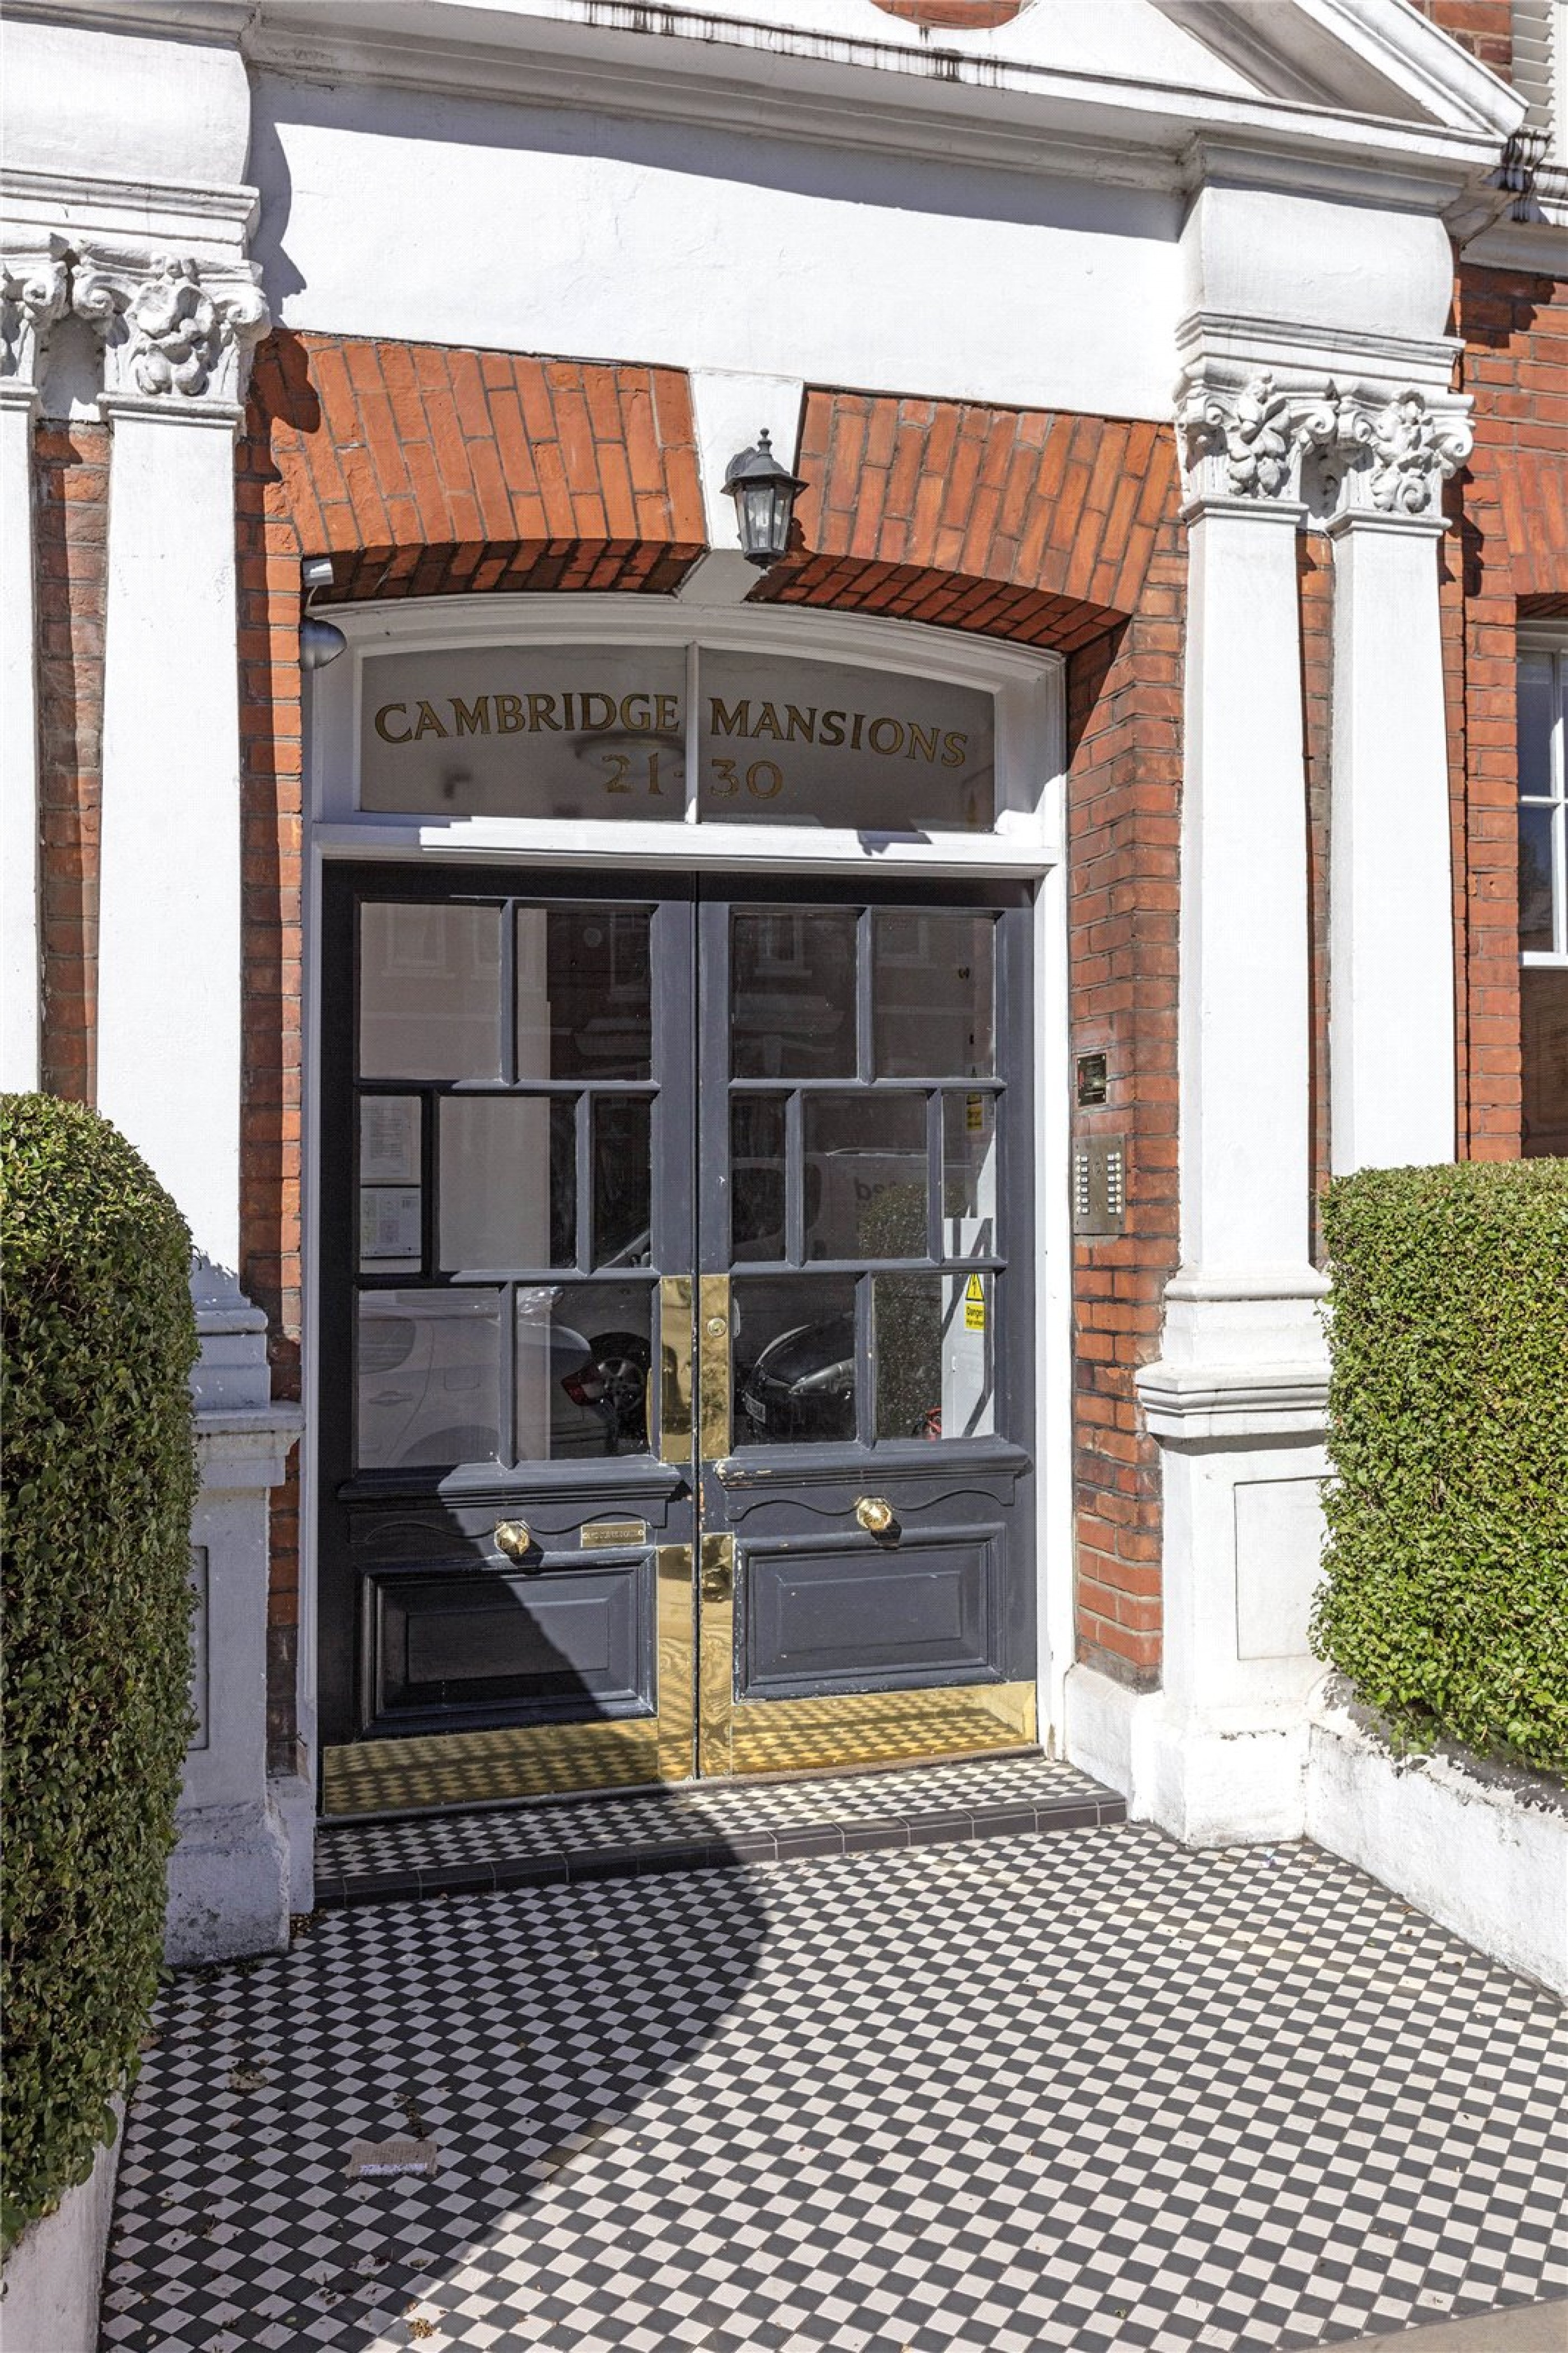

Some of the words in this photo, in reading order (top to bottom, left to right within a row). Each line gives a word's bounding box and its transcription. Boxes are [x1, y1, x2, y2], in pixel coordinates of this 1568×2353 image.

[375, 693, 679, 743] CAMBRIDGE
[708, 698, 968, 768] MANSIONS
[601, 753, 662, 795] 21
[711, 759, 782, 798] 30
